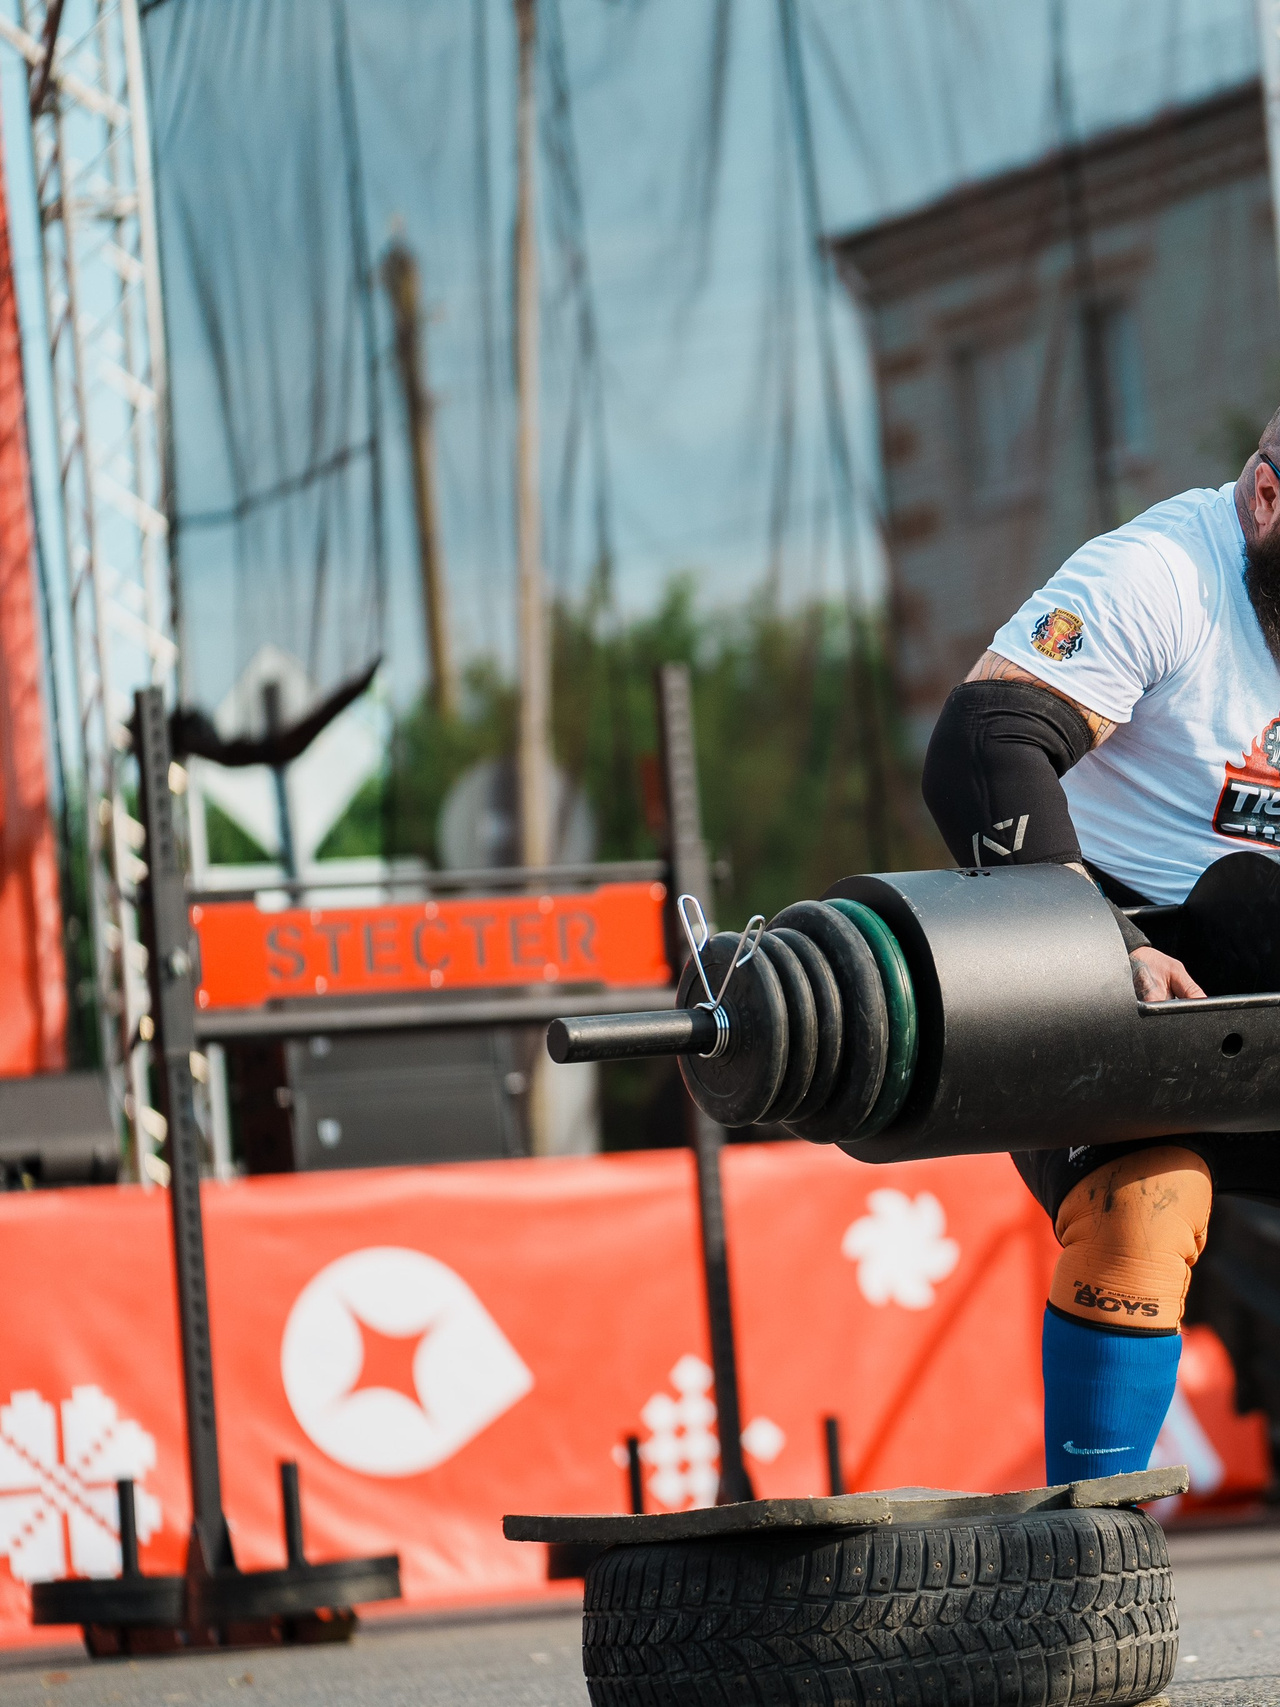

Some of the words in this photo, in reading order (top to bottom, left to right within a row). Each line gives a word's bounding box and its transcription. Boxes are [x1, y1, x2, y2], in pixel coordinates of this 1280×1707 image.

[266, 911, 597, 980] STECTER
[1074, 1280, 1104, 1295] FAT
[1074, 1289, 1160, 1317] BOYS
